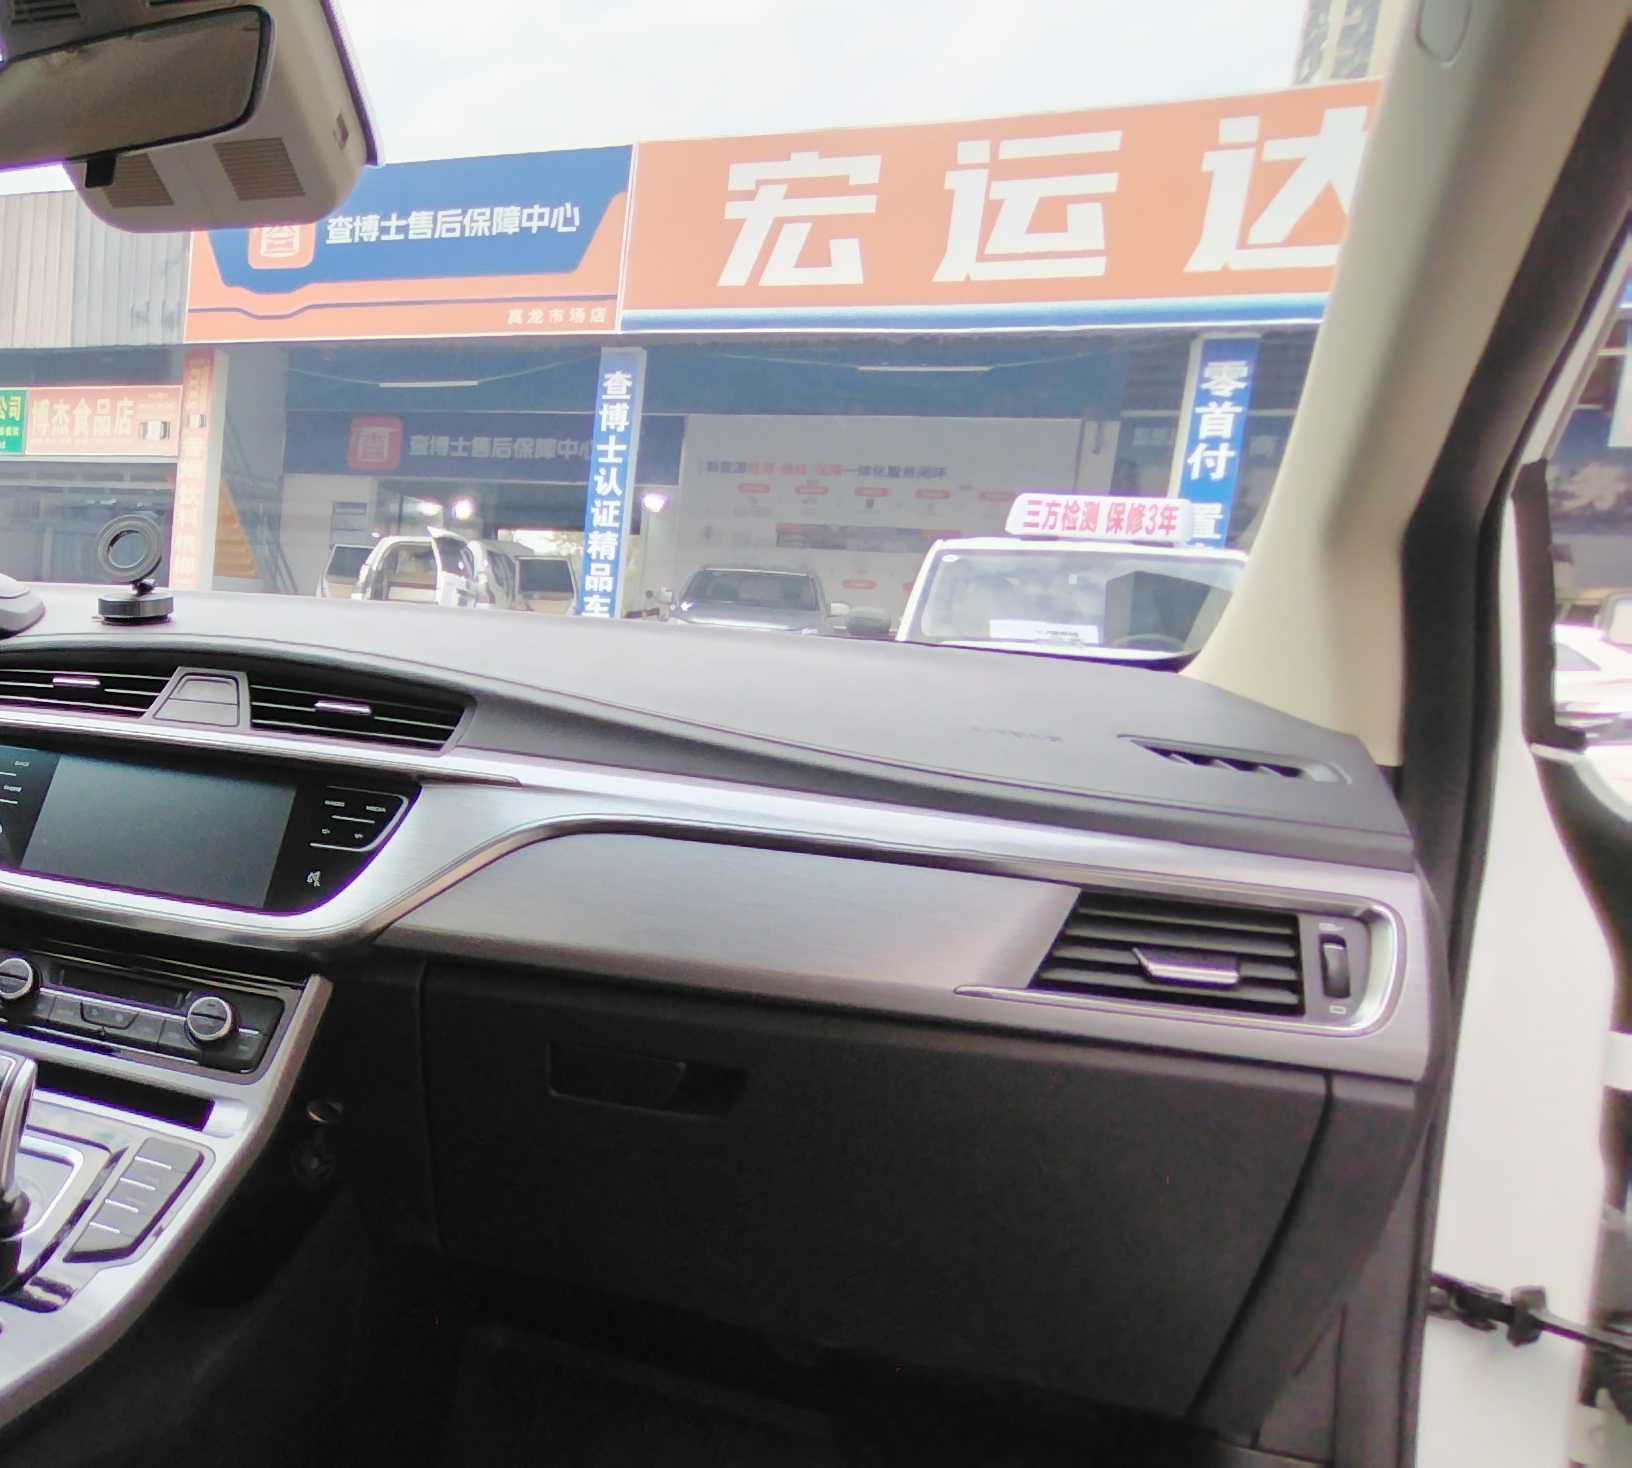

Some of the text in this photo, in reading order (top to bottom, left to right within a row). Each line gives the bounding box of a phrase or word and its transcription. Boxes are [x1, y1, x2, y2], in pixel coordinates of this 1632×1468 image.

[325, 201, 581, 245] 查博士售后保障中心
[717, 105, 1369, 286] 宏运达
[1187, 360, 1250, 481] 零首付
[582, 370, 632, 618] 查博士认证精品车
[1023, 498, 1179, 537] 三方检测 保修3年
